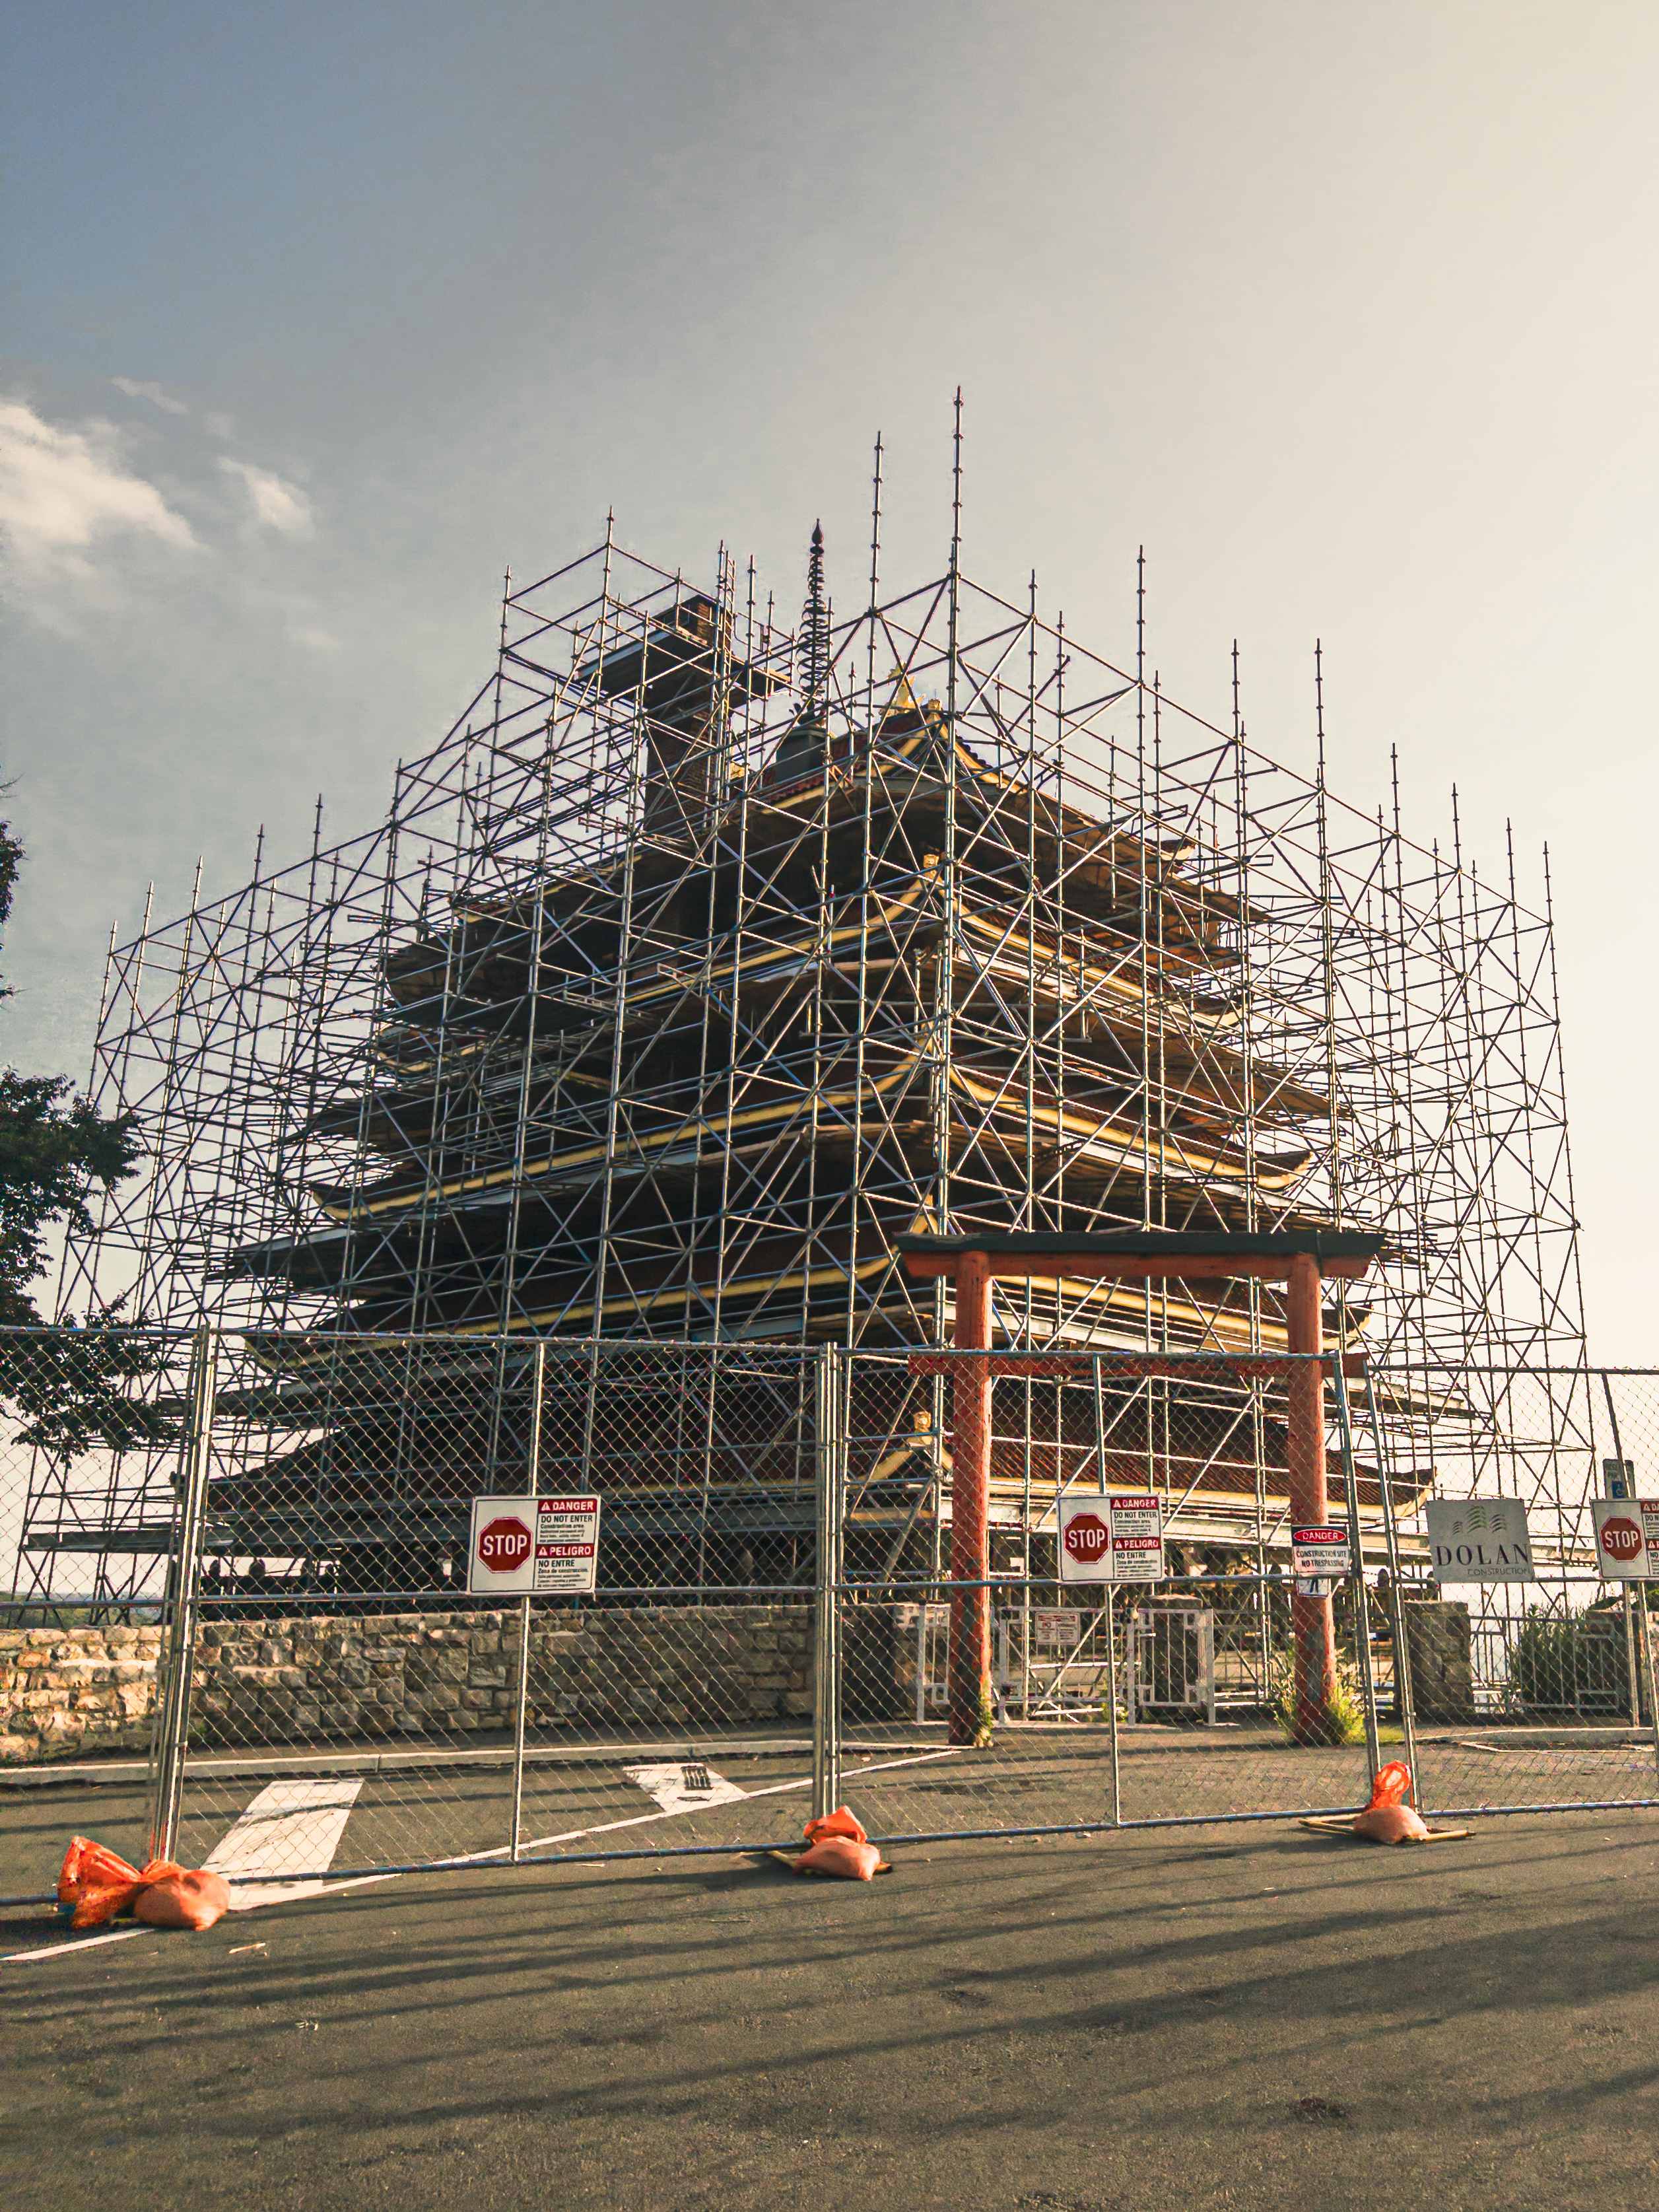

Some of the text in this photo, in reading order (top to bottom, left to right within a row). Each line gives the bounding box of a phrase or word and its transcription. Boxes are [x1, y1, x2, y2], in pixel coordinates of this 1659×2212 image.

[553, 1501, 593, 1511] DANGER
[1122, 1499, 1157, 1508] DANGER
[1068, 1528, 1105, 1548] STOP
[1302, 1531, 1339, 1540] DANGER
[1604, 1530, 1639, 1548] STOP
[482, 1534, 527, 1556] STOP
[1124, 1539, 1159, 1548] PELIGRO
[549, 1546, 591, 1556] PELIGRO
[1436, 1544, 1530, 1566] DOLAN
[551, 1559, 575, 1568] ENTRE
[1468, 1568, 1531, 1576] CONSTRUCTION
